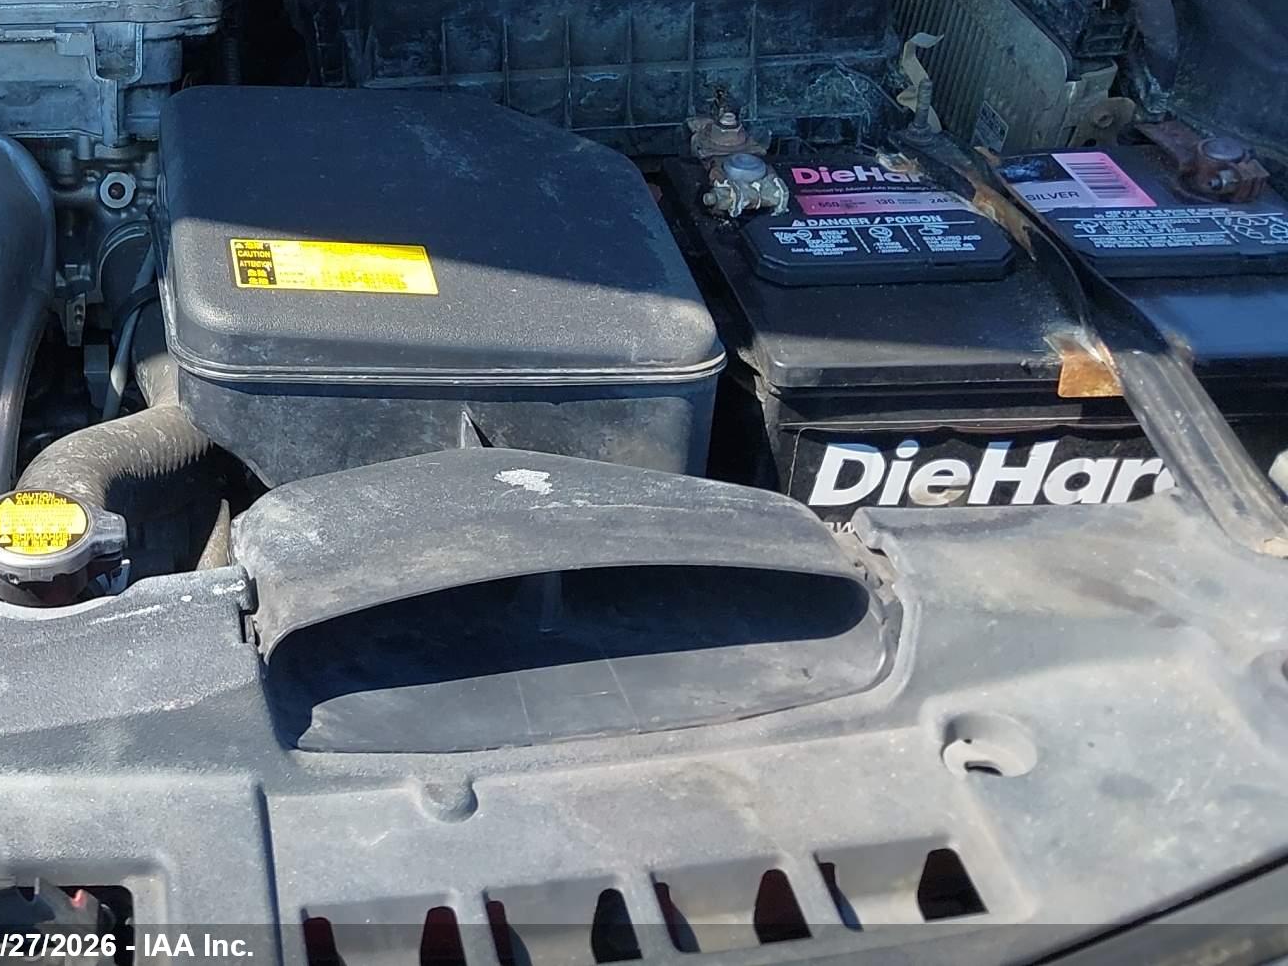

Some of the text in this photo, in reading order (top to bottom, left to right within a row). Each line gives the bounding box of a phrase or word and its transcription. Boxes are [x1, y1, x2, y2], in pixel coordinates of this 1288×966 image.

[790, 165, 925, 184] DieHar
[1024, 191, 1080, 202] SILVER
[806, 214, 943, 227] DANGER / POISON
[237, 250, 271, 258] CAUTION
[808, 439, 1176, 507] DieHar
[15, 492, 56, 500] CAUTION
[15, 497, 67, 505] ATTENTION
